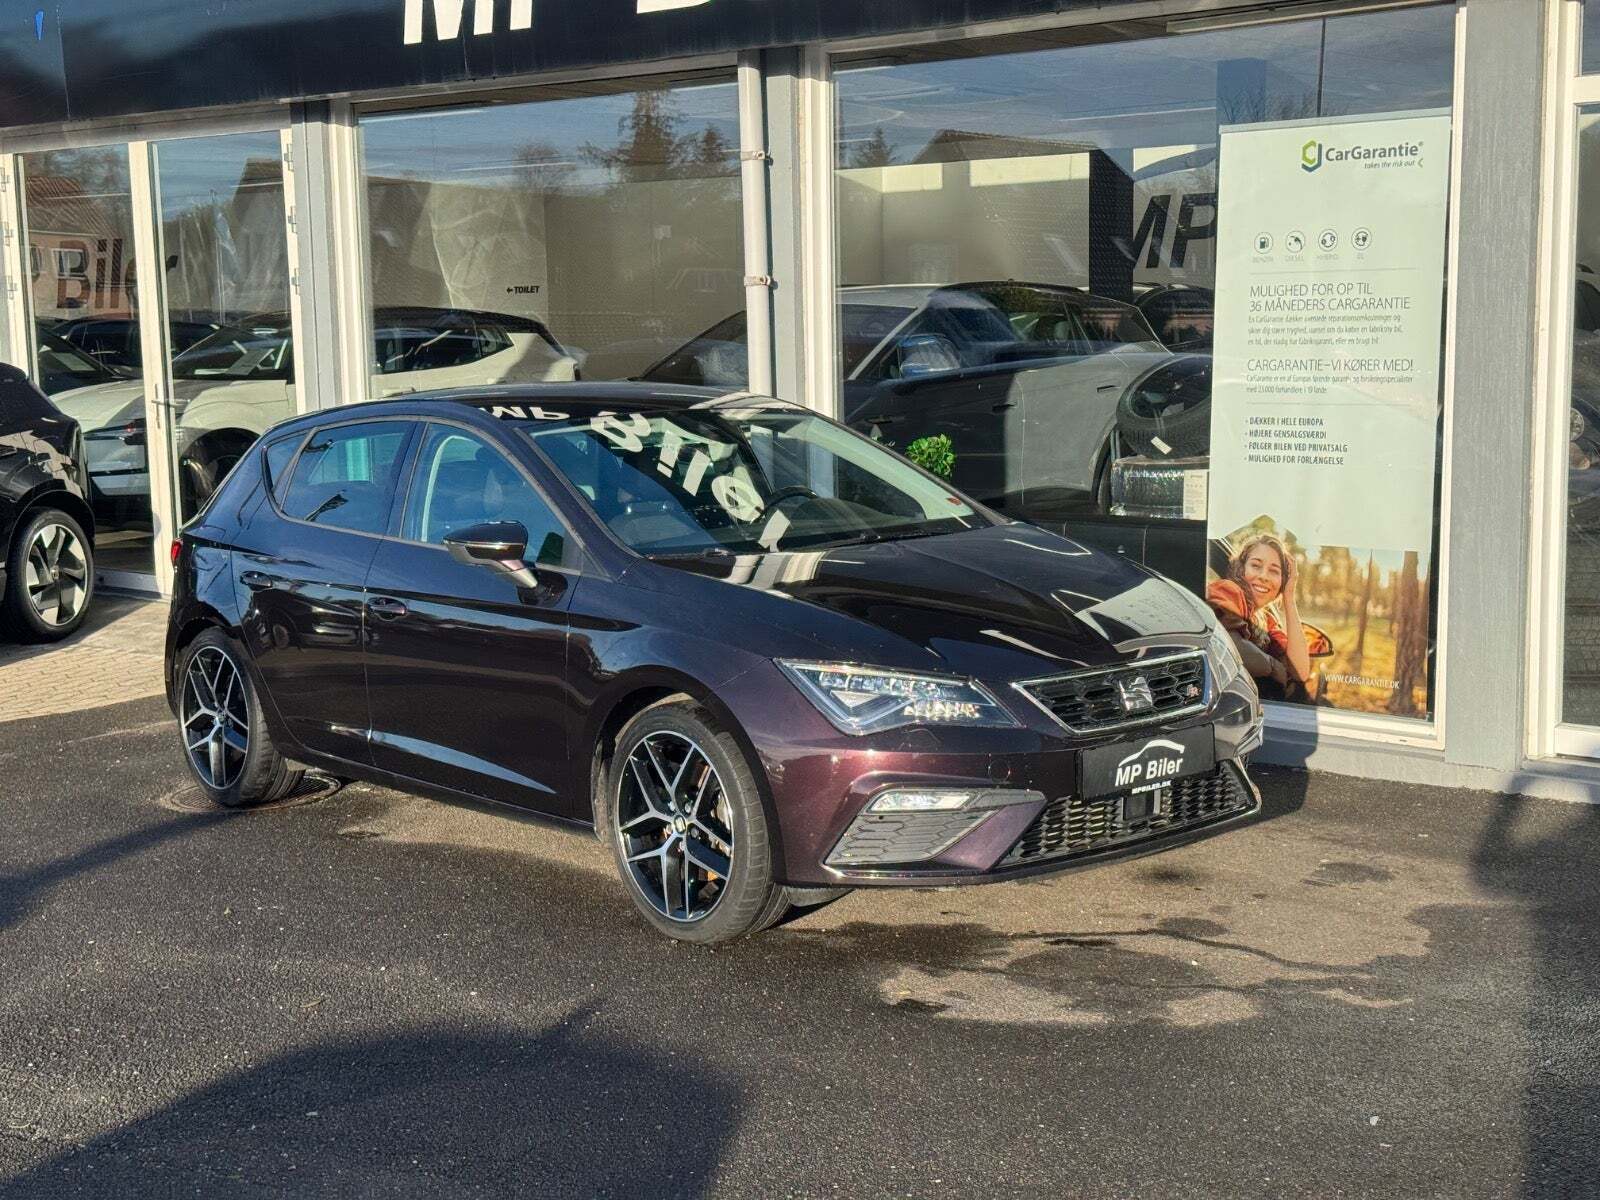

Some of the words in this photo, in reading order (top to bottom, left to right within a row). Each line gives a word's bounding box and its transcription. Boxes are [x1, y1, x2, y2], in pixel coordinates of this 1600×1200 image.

[514, 286, 540, 294] TOILET
[1250, 284, 1308, 298] MULIGHED
[1312, 283, 1334, 296] FOR
[1336, 282, 1354, 296] OP
[1357, 282, 1373, 295] TIL
[1249, 300, 1262, 312] 36
[1264, 298, 1325, 312] MÅNEDERS
[1328, 296, 1410, 310] CARGARANTIE
[1344, 358, 1380, 372] KØRER
[1384, 359, 1413, 372] MED!
[1250, 416, 1276, 425] DÆKKER
[1281, 417, 1297, 426] HELE
[1298, 418, 1324, 426] EUROPA
[1250, 430, 1272, 438] HØJERE
[1274, 430, 1326, 439] GENSALGSVÆRDI
[1248, 442, 1272, 450] FØLGER
[1274, 442, 1292, 450] BILEN
[1294, 443, 1306, 451] VED
[1308, 443, 1348, 452] PRIVATSALG
[1248, 454, 1280, 463] MULIGHED
[1283, 455, 1295, 464] FOR
[1297, 456, 1344, 464] FORLÆNGELSE
[1115, 764, 1142, 786] MP
[1146, 758, 1183, 780] Biler
